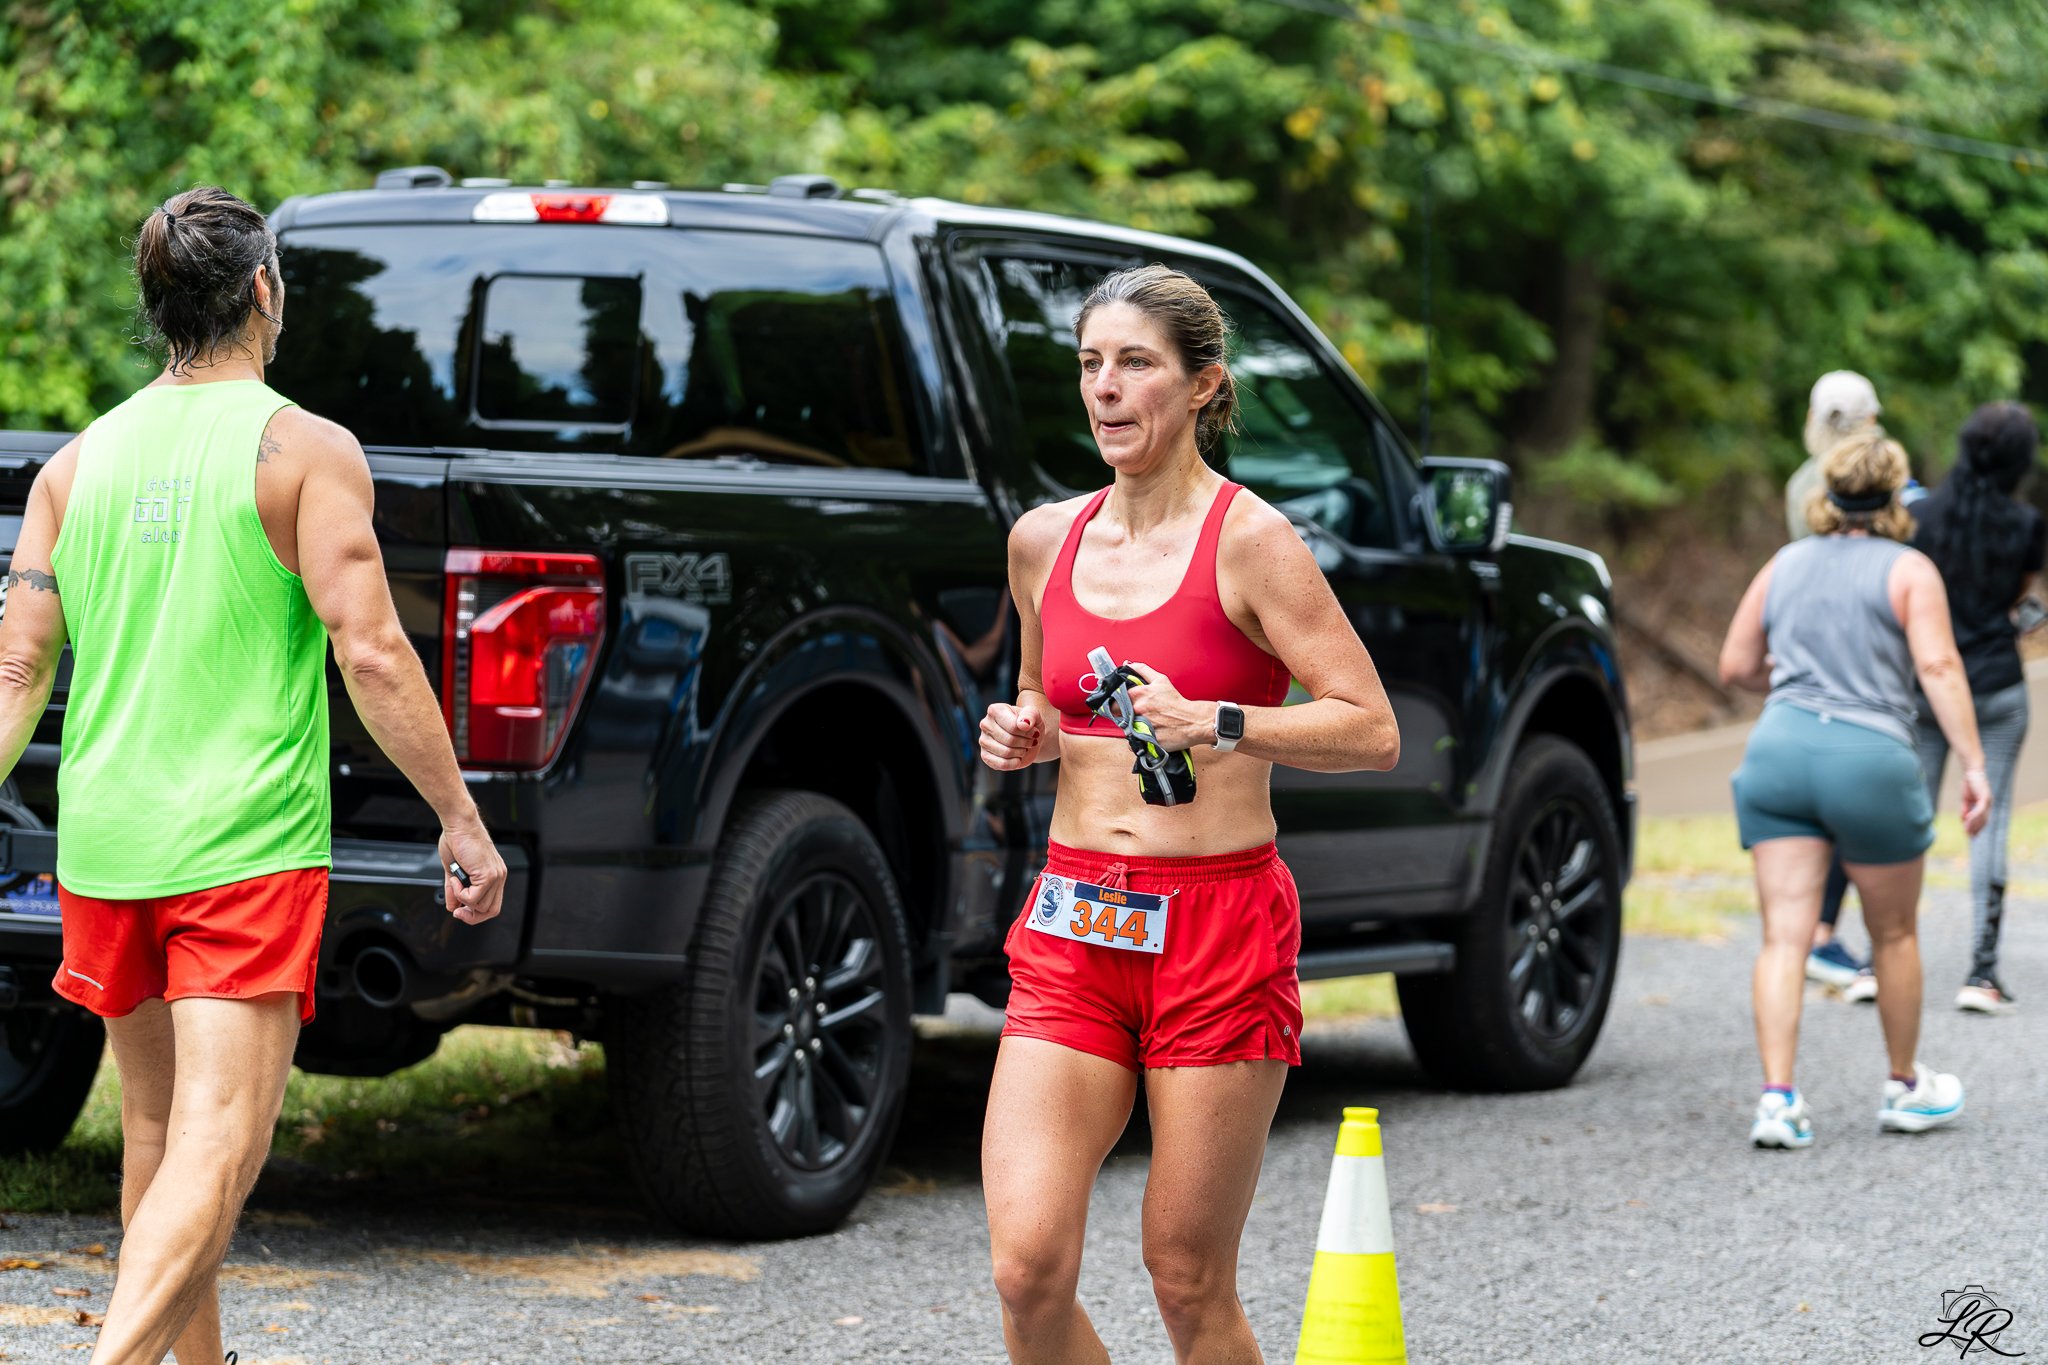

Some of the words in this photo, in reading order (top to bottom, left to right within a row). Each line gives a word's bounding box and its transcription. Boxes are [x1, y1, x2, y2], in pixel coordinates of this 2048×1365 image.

[134, 496, 168, 522] GO
[624, 552, 732, 603] FX4
[1098, 888, 1128, 905] Leslie
[1070, 900, 1149, 947] 344
